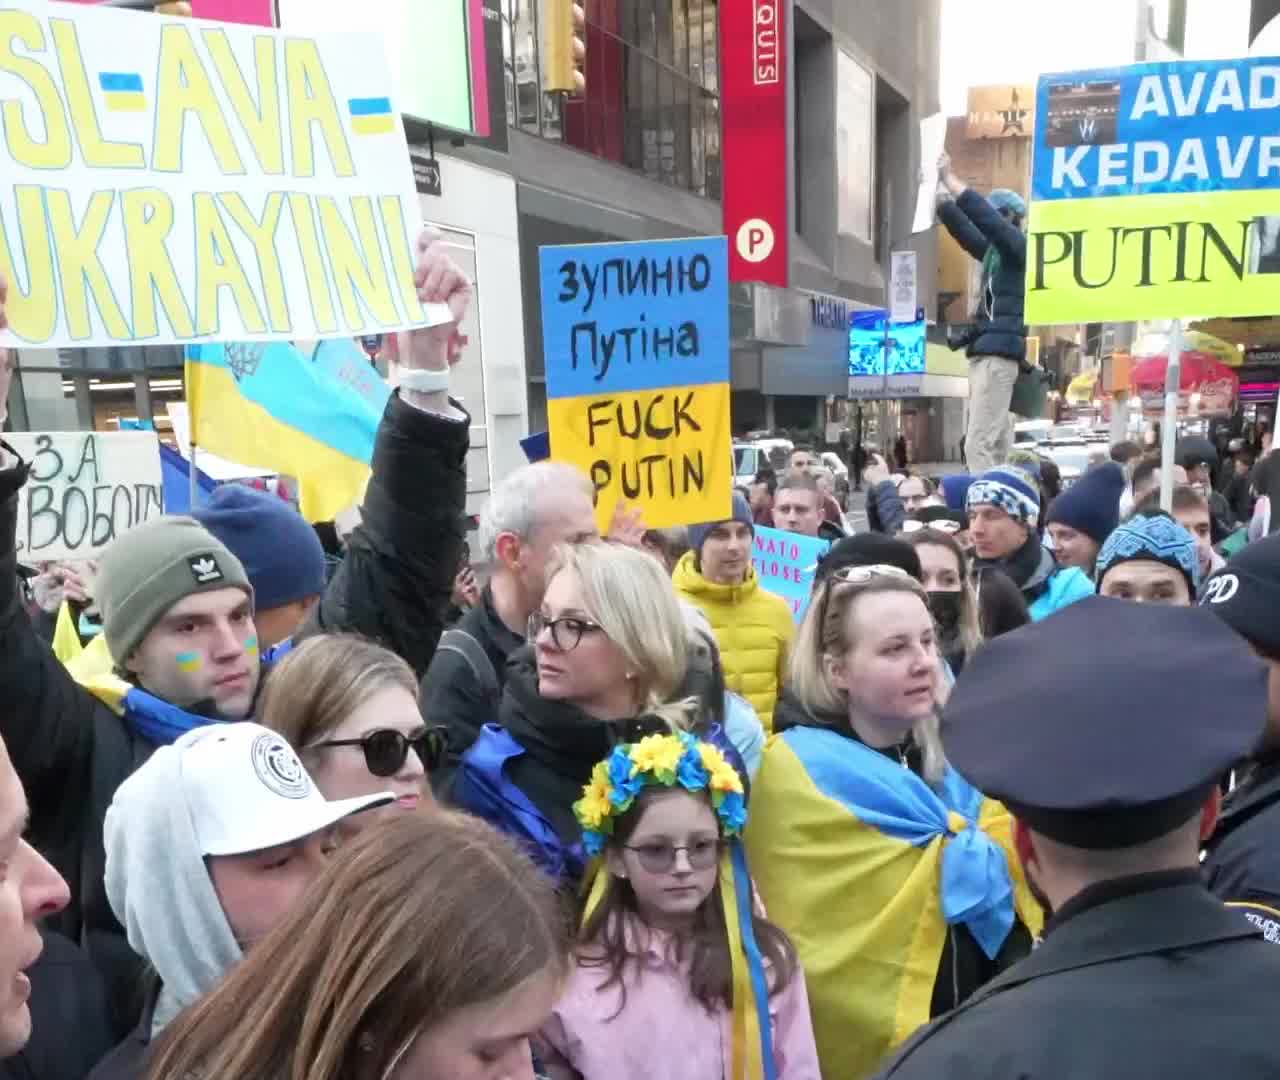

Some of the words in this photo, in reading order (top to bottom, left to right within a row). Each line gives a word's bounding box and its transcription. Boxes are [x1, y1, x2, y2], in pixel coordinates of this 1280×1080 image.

[749, 227, 765, 255] P
[1029, 219, 1257, 292] PUTIN
[570, 312, 699, 381] Путіна
[587, 392, 702, 447] FUCK
[589, 450, 705, 508] PUTIN
